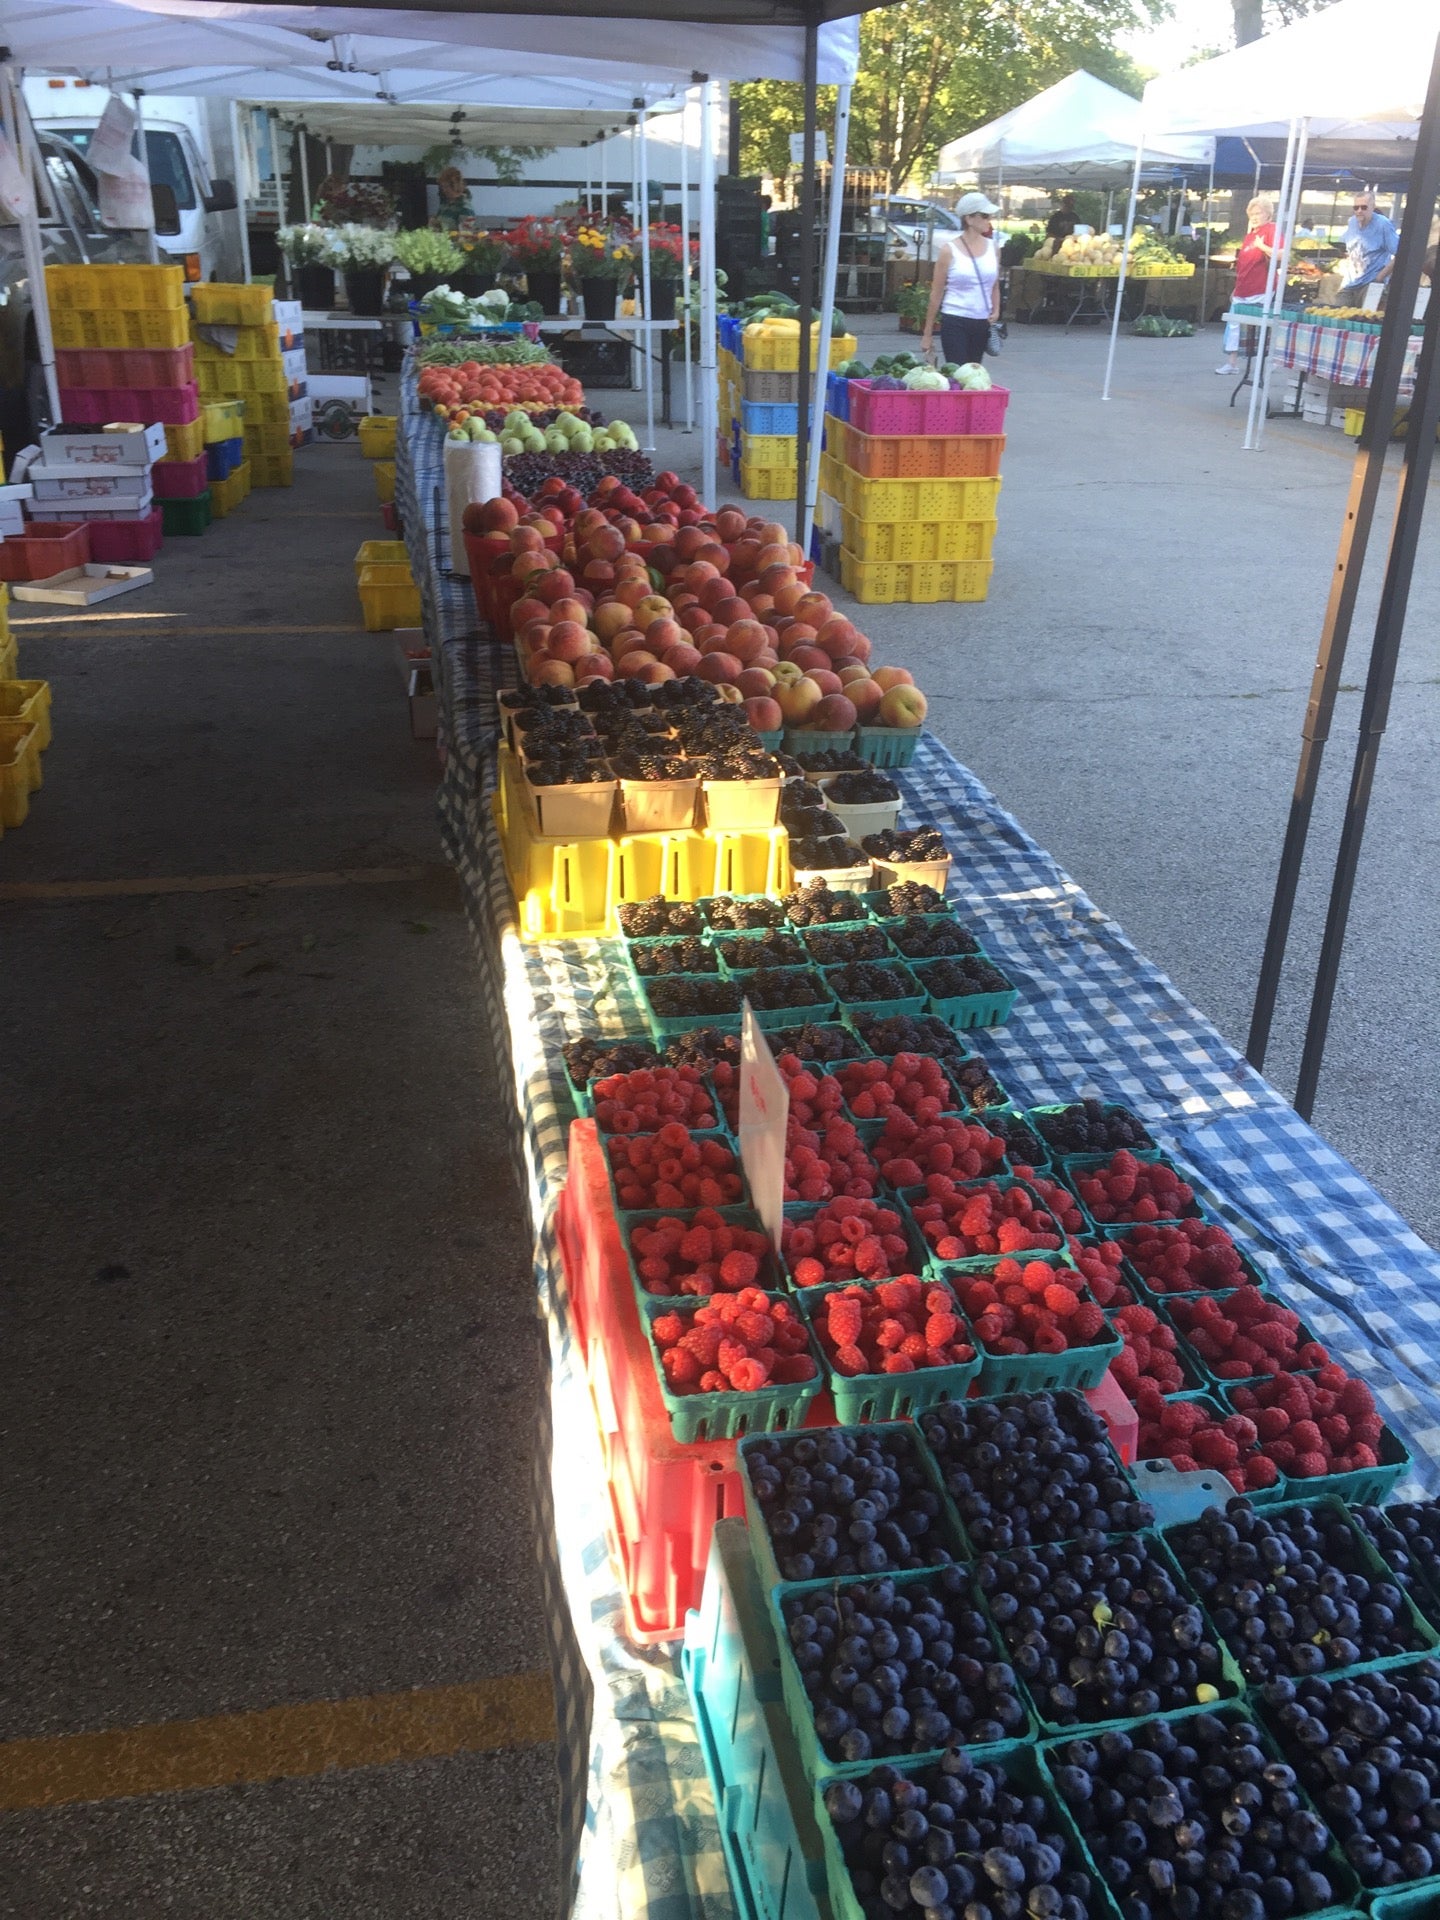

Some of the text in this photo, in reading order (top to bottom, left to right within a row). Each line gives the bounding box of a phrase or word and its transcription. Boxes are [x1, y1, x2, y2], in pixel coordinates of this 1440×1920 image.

[1073, 266, 1091, 276] BUY
[1135, 266, 1153, 276] EAT
[1160, 265, 1190, 276] FRESH
